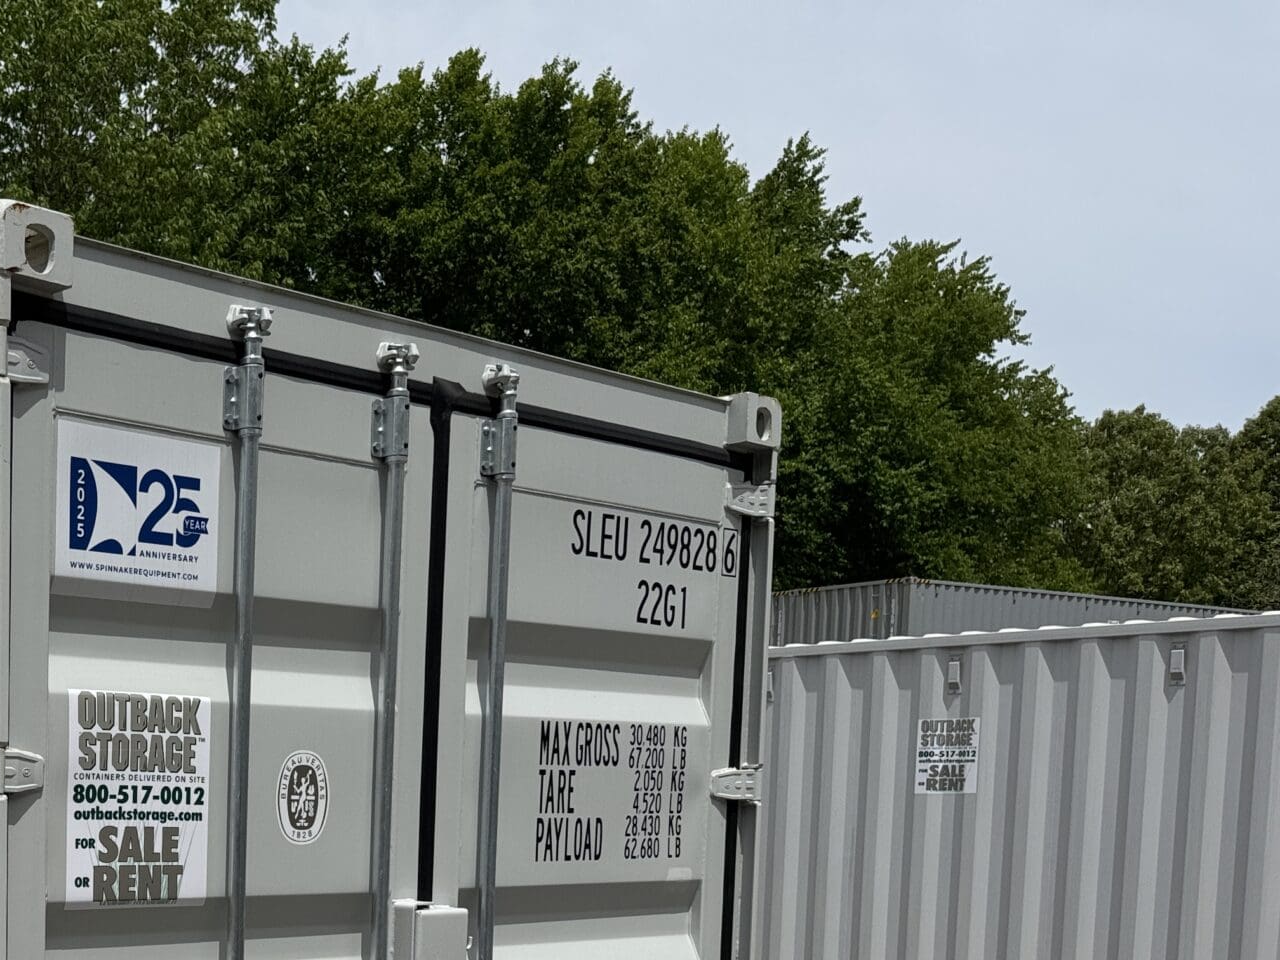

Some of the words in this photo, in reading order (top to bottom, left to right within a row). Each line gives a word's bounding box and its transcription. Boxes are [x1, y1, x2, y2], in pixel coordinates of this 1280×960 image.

[76, 469, 86, 538] 2025
[138, 469, 201, 548] 25
[184, 517, 206, 532] YEAR
[571, 509, 629, 561] SLEU
[639, 519, 717, 572] 249828
[724, 533, 736, 574] 6
[139, 550, 199, 563] ANNIVERSARY
[70, 561, 199, 581] WWW.SPINNAKEREQUIPMENT.COM
[636, 579, 687, 629] 22G1
[77, 690, 202, 735] OUTBACK
[673, 725, 687, 747] KG
[921, 719, 975, 733] OUTBACK
[539, 720, 571, 766] MAX
[575, 722, 621, 767] GROSS
[672, 749, 687, 770] LB
[928, 764, 965, 778] SALE
[73, 772, 126, 781] CONTAINERS
[128, 773, 172, 782] DELIVERED
[174, 775, 186, 783] ON
[188, 776, 206, 784] SITE
[280, 756, 302, 801] BUREAU
[306, 756, 326, 801] VERITAS
[670, 770, 685, 792] KG
[925, 778, 967, 792] RENT
[73, 784, 206, 806] 800-517-0012
[538, 769, 576, 814] TARE
[74, 806, 203, 823] outbackstorage.com
[668, 792, 683, 815] LB
[667, 814, 682, 837] KG
[75, 838, 96, 849] FOR
[98, 825, 180, 863] SALE
[535, 817, 603, 862] PAYLOAD
[667, 836, 681, 859] LB
[74, 877, 90, 888] OR
[93, 864, 184, 903] RENT
